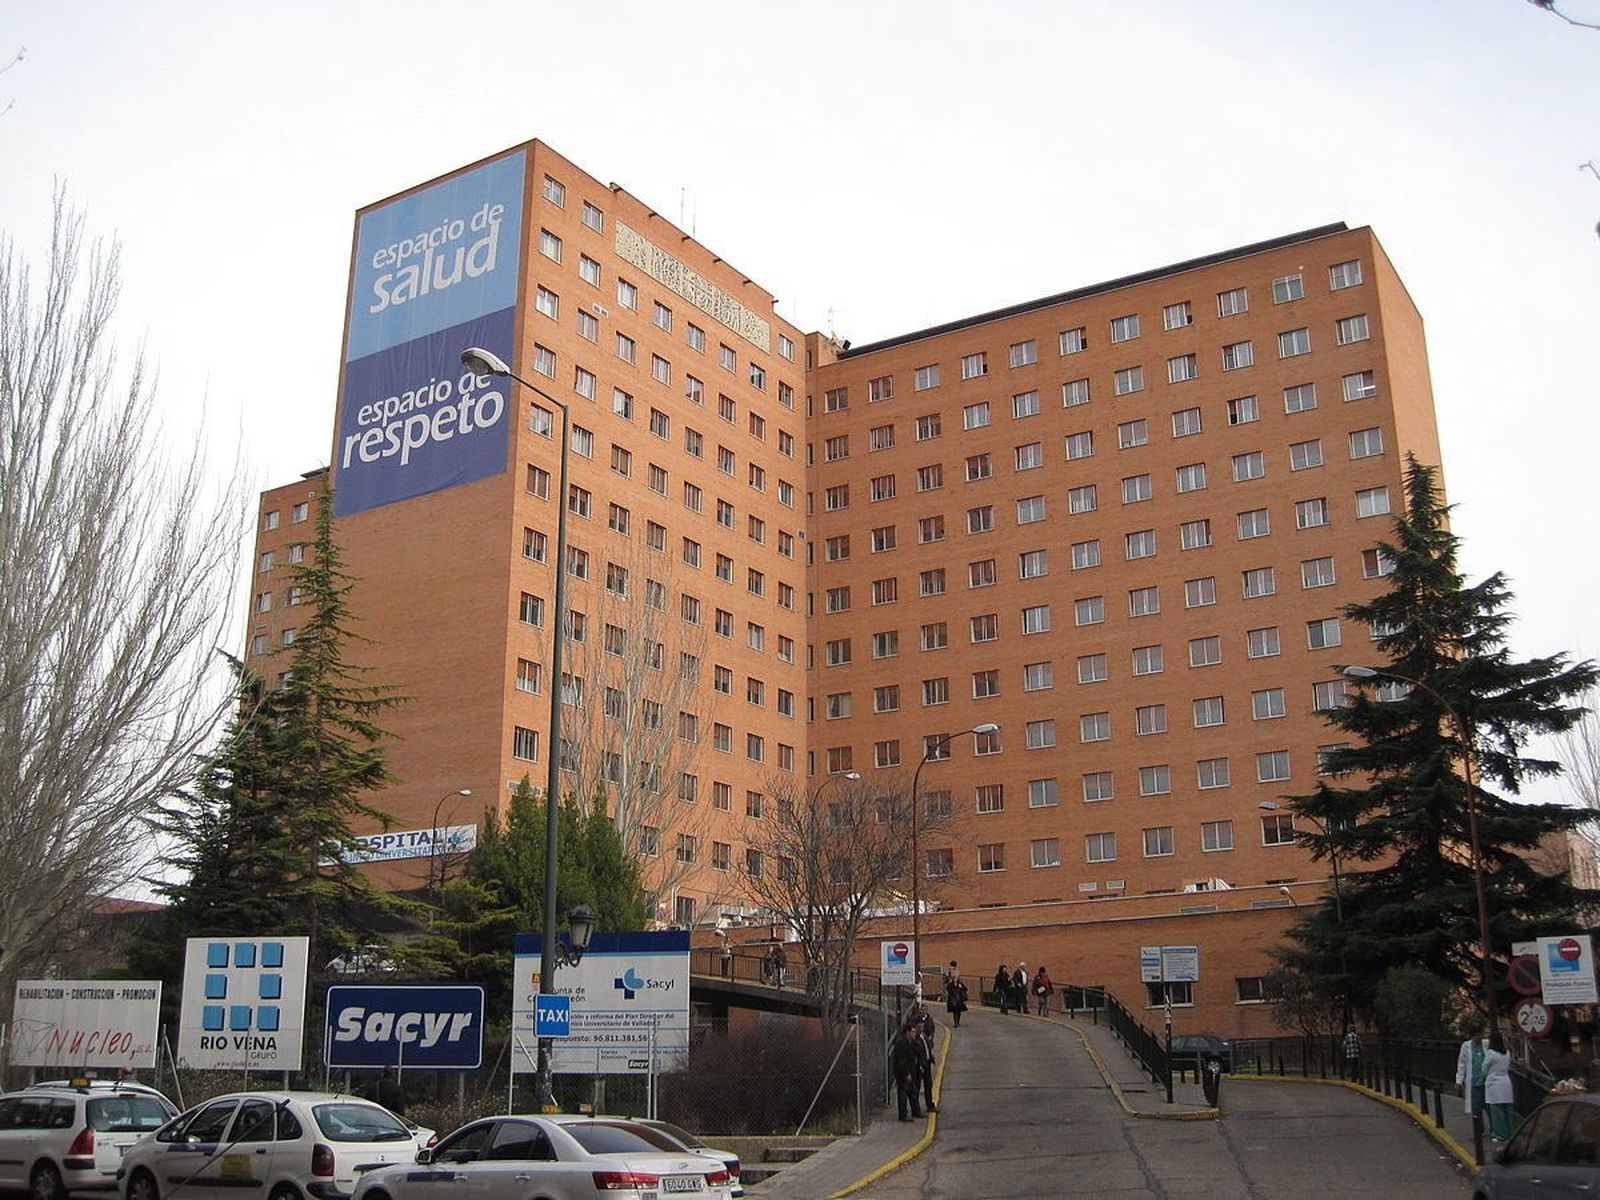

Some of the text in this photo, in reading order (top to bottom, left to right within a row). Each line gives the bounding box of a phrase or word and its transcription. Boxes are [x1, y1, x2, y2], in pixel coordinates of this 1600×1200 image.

[372, 203, 505, 269] espacio de
[369, 221, 500, 315] salud
[357, 377, 452, 426] espacio
[342, 390, 505, 470] respeto
[19, 988, 64, 999] REHABILITACION
[71, 988, 115, 999] CONSTRUCCION
[122, 989, 156, 1000] PROMOCION
[554, 986, 586, 994] unta de
[646, 978, 675, 991] Sacyl
[335, 1007, 473, 1047] Sacyr
[538, 1009, 569, 1023] TAXI
[200, 1036, 277, 1050] RIO VENA
